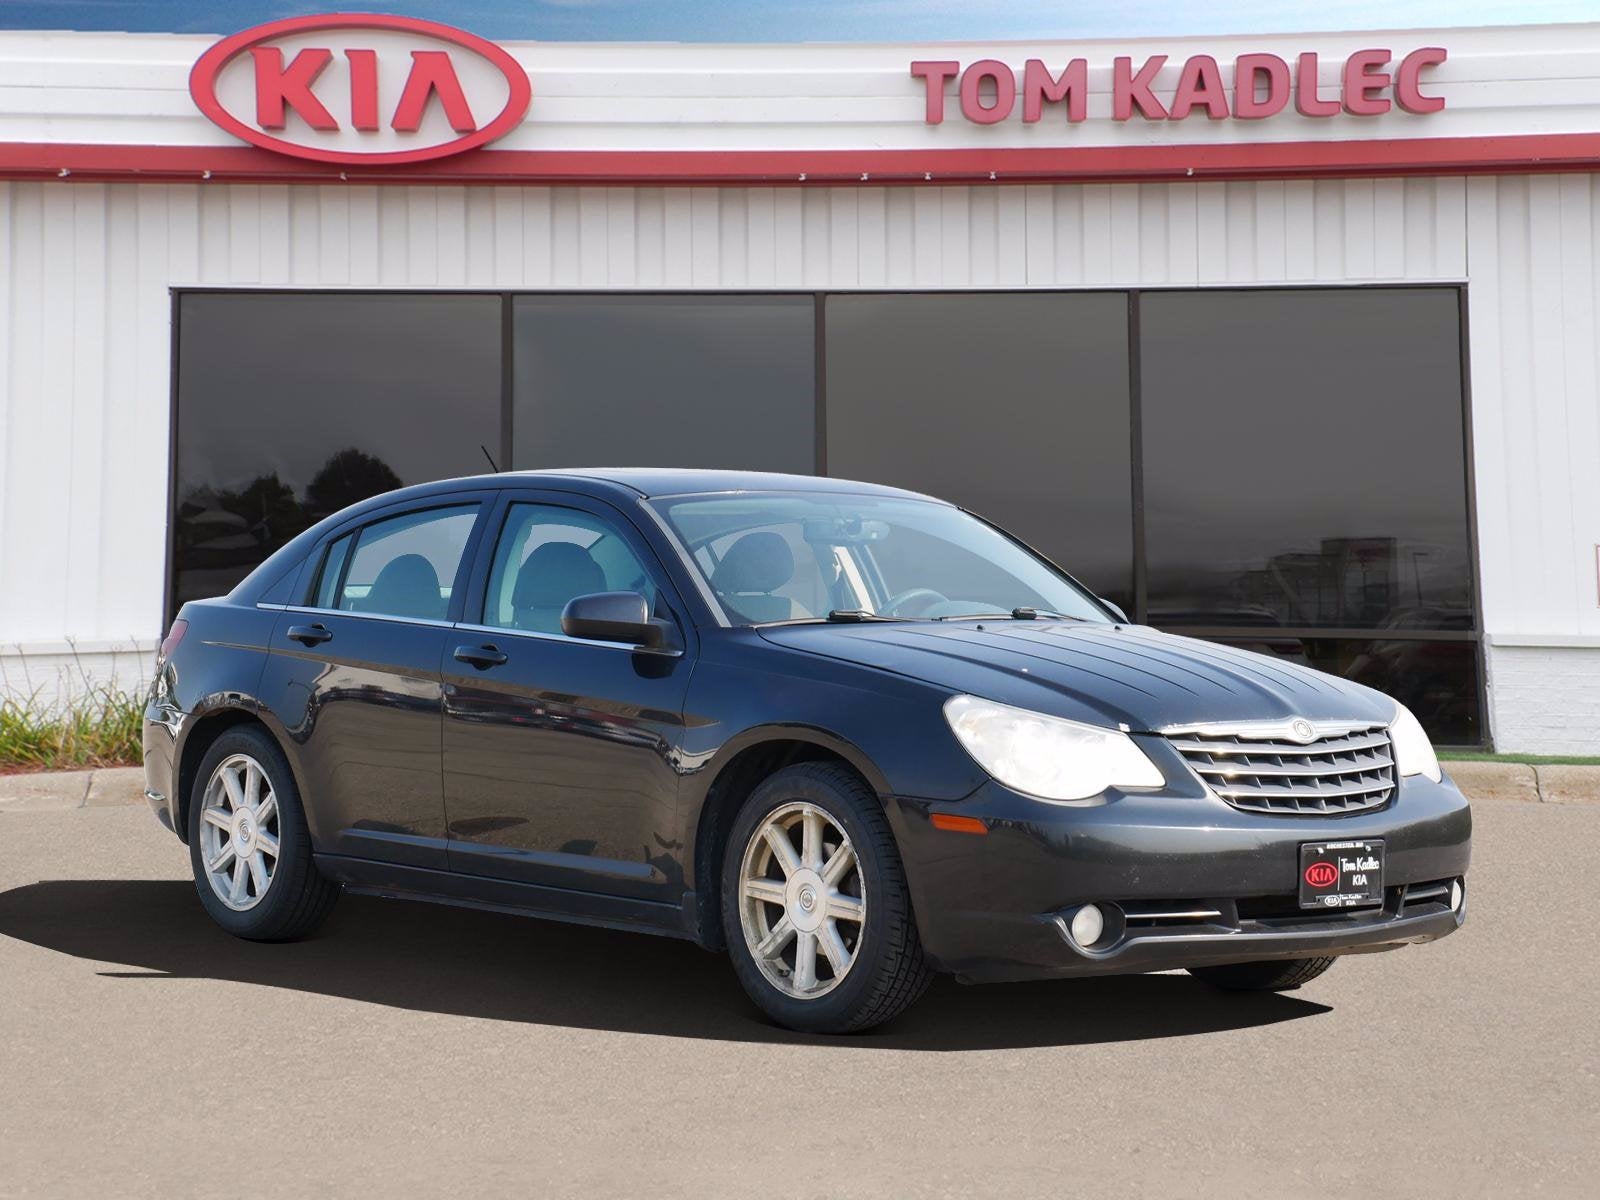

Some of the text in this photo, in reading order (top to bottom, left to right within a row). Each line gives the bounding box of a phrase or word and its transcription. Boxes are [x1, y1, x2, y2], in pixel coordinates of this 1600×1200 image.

[249, 46, 477, 132] KIA
[910, 47, 1448, 126] TOM KADLEC
[1341, 856, 1379, 872] Tom Kadlec
[1311, 868, 1333, 882] KIA
[1352, 874, 1367, 885] KIA
